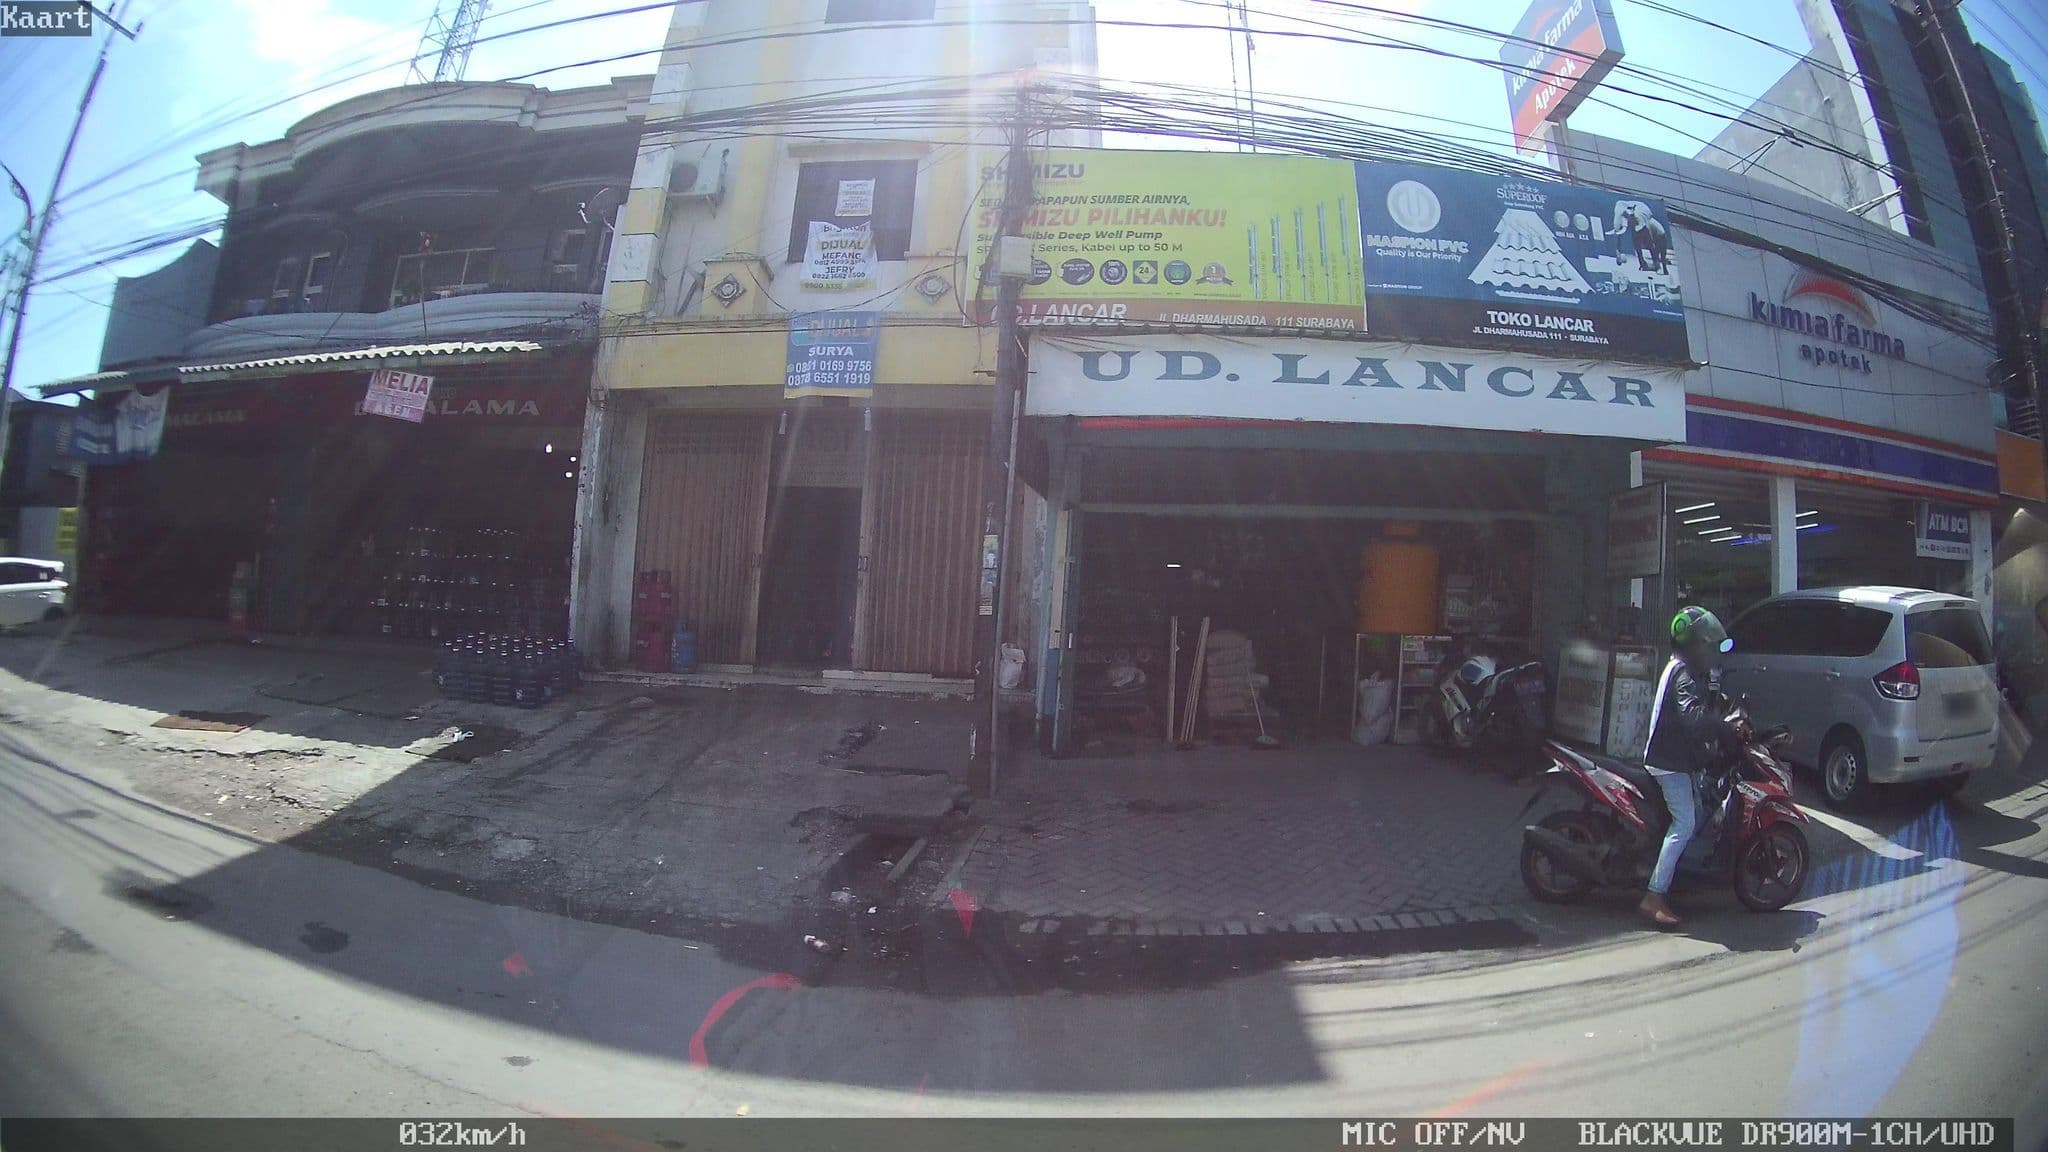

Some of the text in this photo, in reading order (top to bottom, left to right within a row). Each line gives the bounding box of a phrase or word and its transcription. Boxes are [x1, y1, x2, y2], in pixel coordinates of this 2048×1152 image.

[1090, 194, 1141, 205] SUMBER
[1087, 207, 1228, 228] PILIHANKU!
[1057, 231, 1091, 242] Deep
[1094, 230, 1123, 240] Well
[1126, 231, 1163, 241] Pump
[820, 240, 866, 251] DIJUAL
[1038, 243, 1078, 253] Series,
[1081, 243, 1116, 252] Kabel
[1119, 244, 1136, 253] up
[1139, 243, 1151, 252] to
[1154, 243, 1169, 252] 50
[1172, 244, 1183, 252] M
[1376, 248, 1407, 258] Quality
[1432, 252, 1462, 262] Priority
[825, 265, 855, 274] JEFRY
[1172, 313, 1267, 326] DHARMAHUSADA
[1275, 316, 1293, 328] 111
[1296, 317, 1355, 329] SURABAYA
[1487, 310, 1595, 333] TOKO LANCAR
[1483, 326, 1549, 340] DHARMAHUSADA
[1550, 332, 1562, 341] 111
[1569, 334, 1609, 345] SURABAYA
[808, 346, 854, 357] SURYA
[1800, 341, 1873, 375] apotek
[820, 361, 845, 371] 0169
[847, 360, 872, 372] 9756
[372, 370, 429, 395] MELIA
[813, 372, 840, 383] 6551
[843, 373, 871, 384] 1919
[1077, 350, 1656, 408] UD. LANCAR
